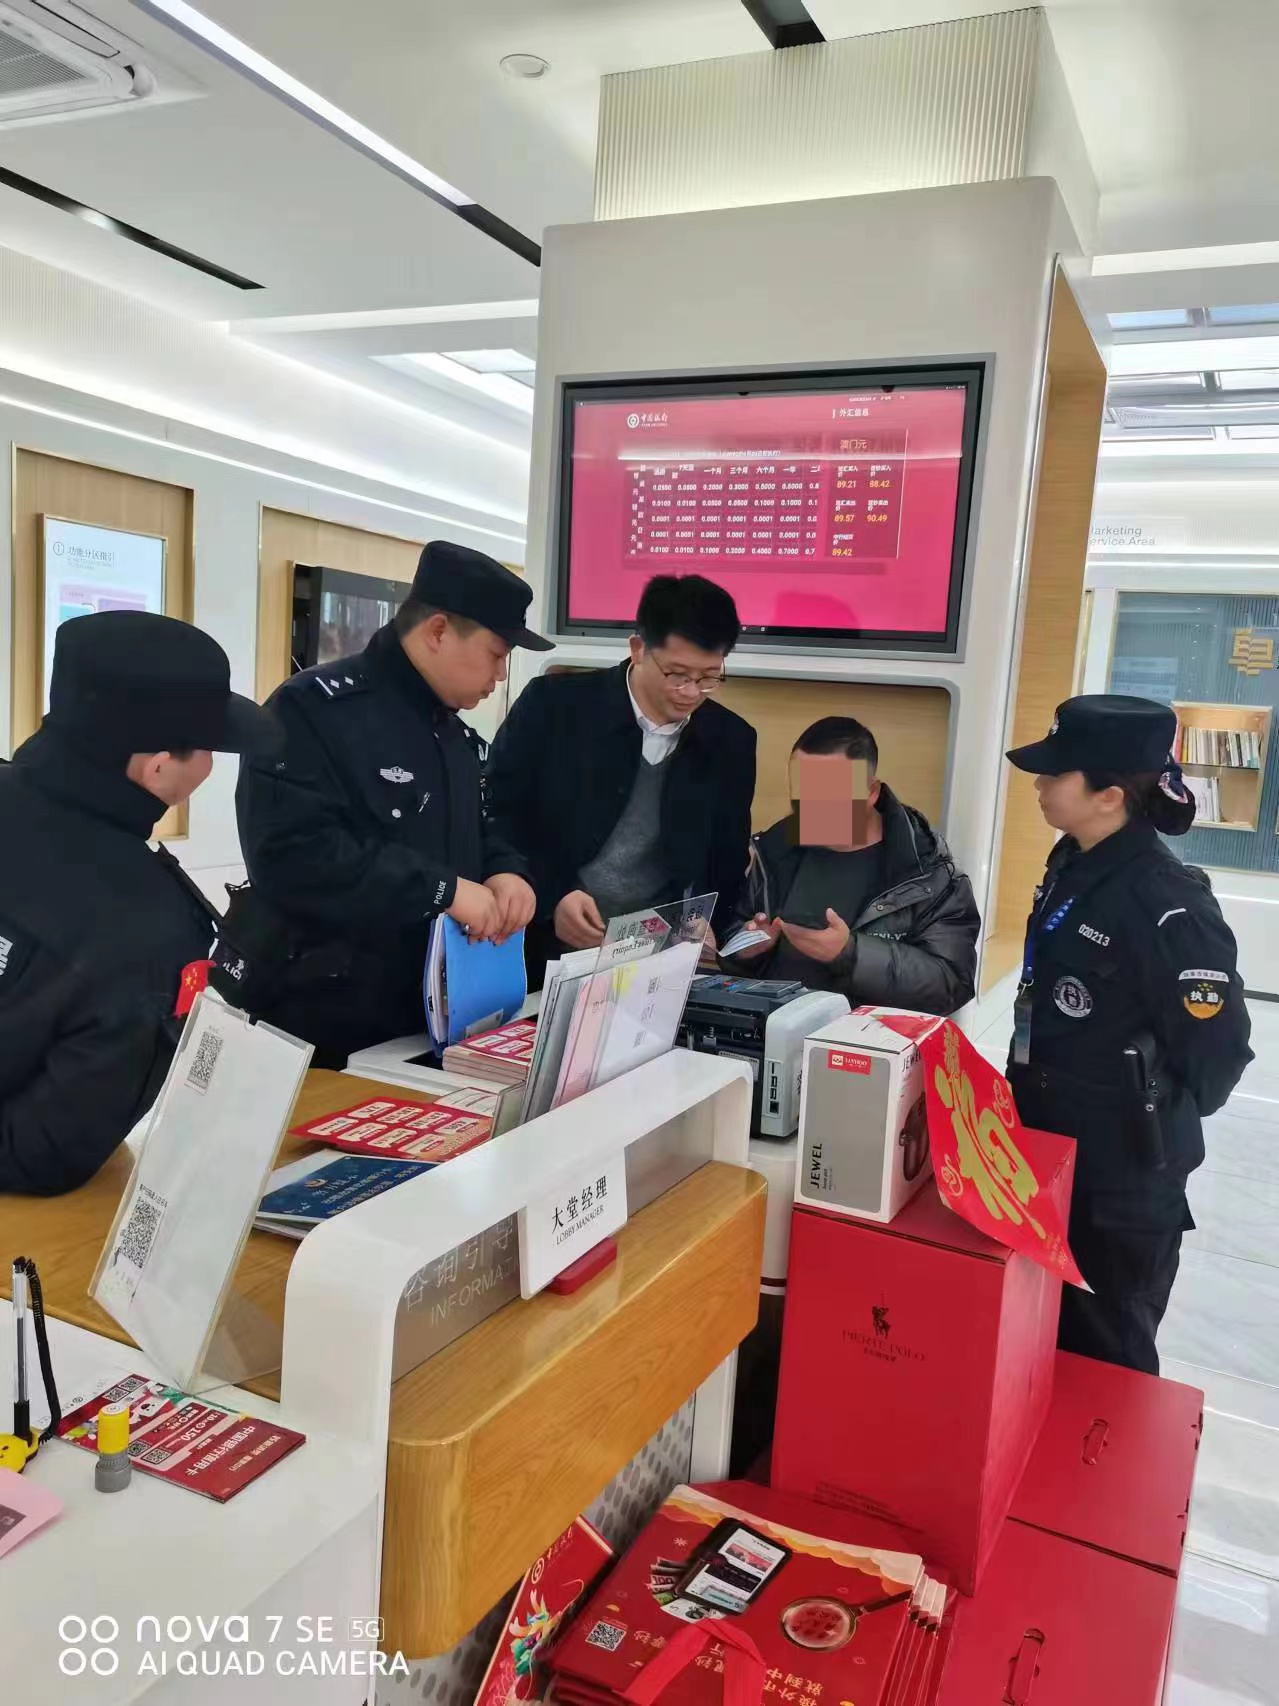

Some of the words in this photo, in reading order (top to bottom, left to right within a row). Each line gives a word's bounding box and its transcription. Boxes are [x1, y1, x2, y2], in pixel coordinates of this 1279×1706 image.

[840, 408, 868, 416] 外汇信息
[730, 466, 748, 474] 三个月
[837, 480, 856, 488] 89.21
[1128, 537, 1155, 546] Area
[433, 880, 447, 905] POLICE
[1078, 924, 1111, 947] 020213
[810, 1143, 823, 1189] JEWEL
[551, 1175, 608, 1235] 大堂经理
[556, 1224, 575, 1246] LOBBY
[576, 1204, 605, 1231] MANAGER
[185, 1425, 256, 1476] 中国银行信用卡
[767, 1668, 824, 1696] 就到中
